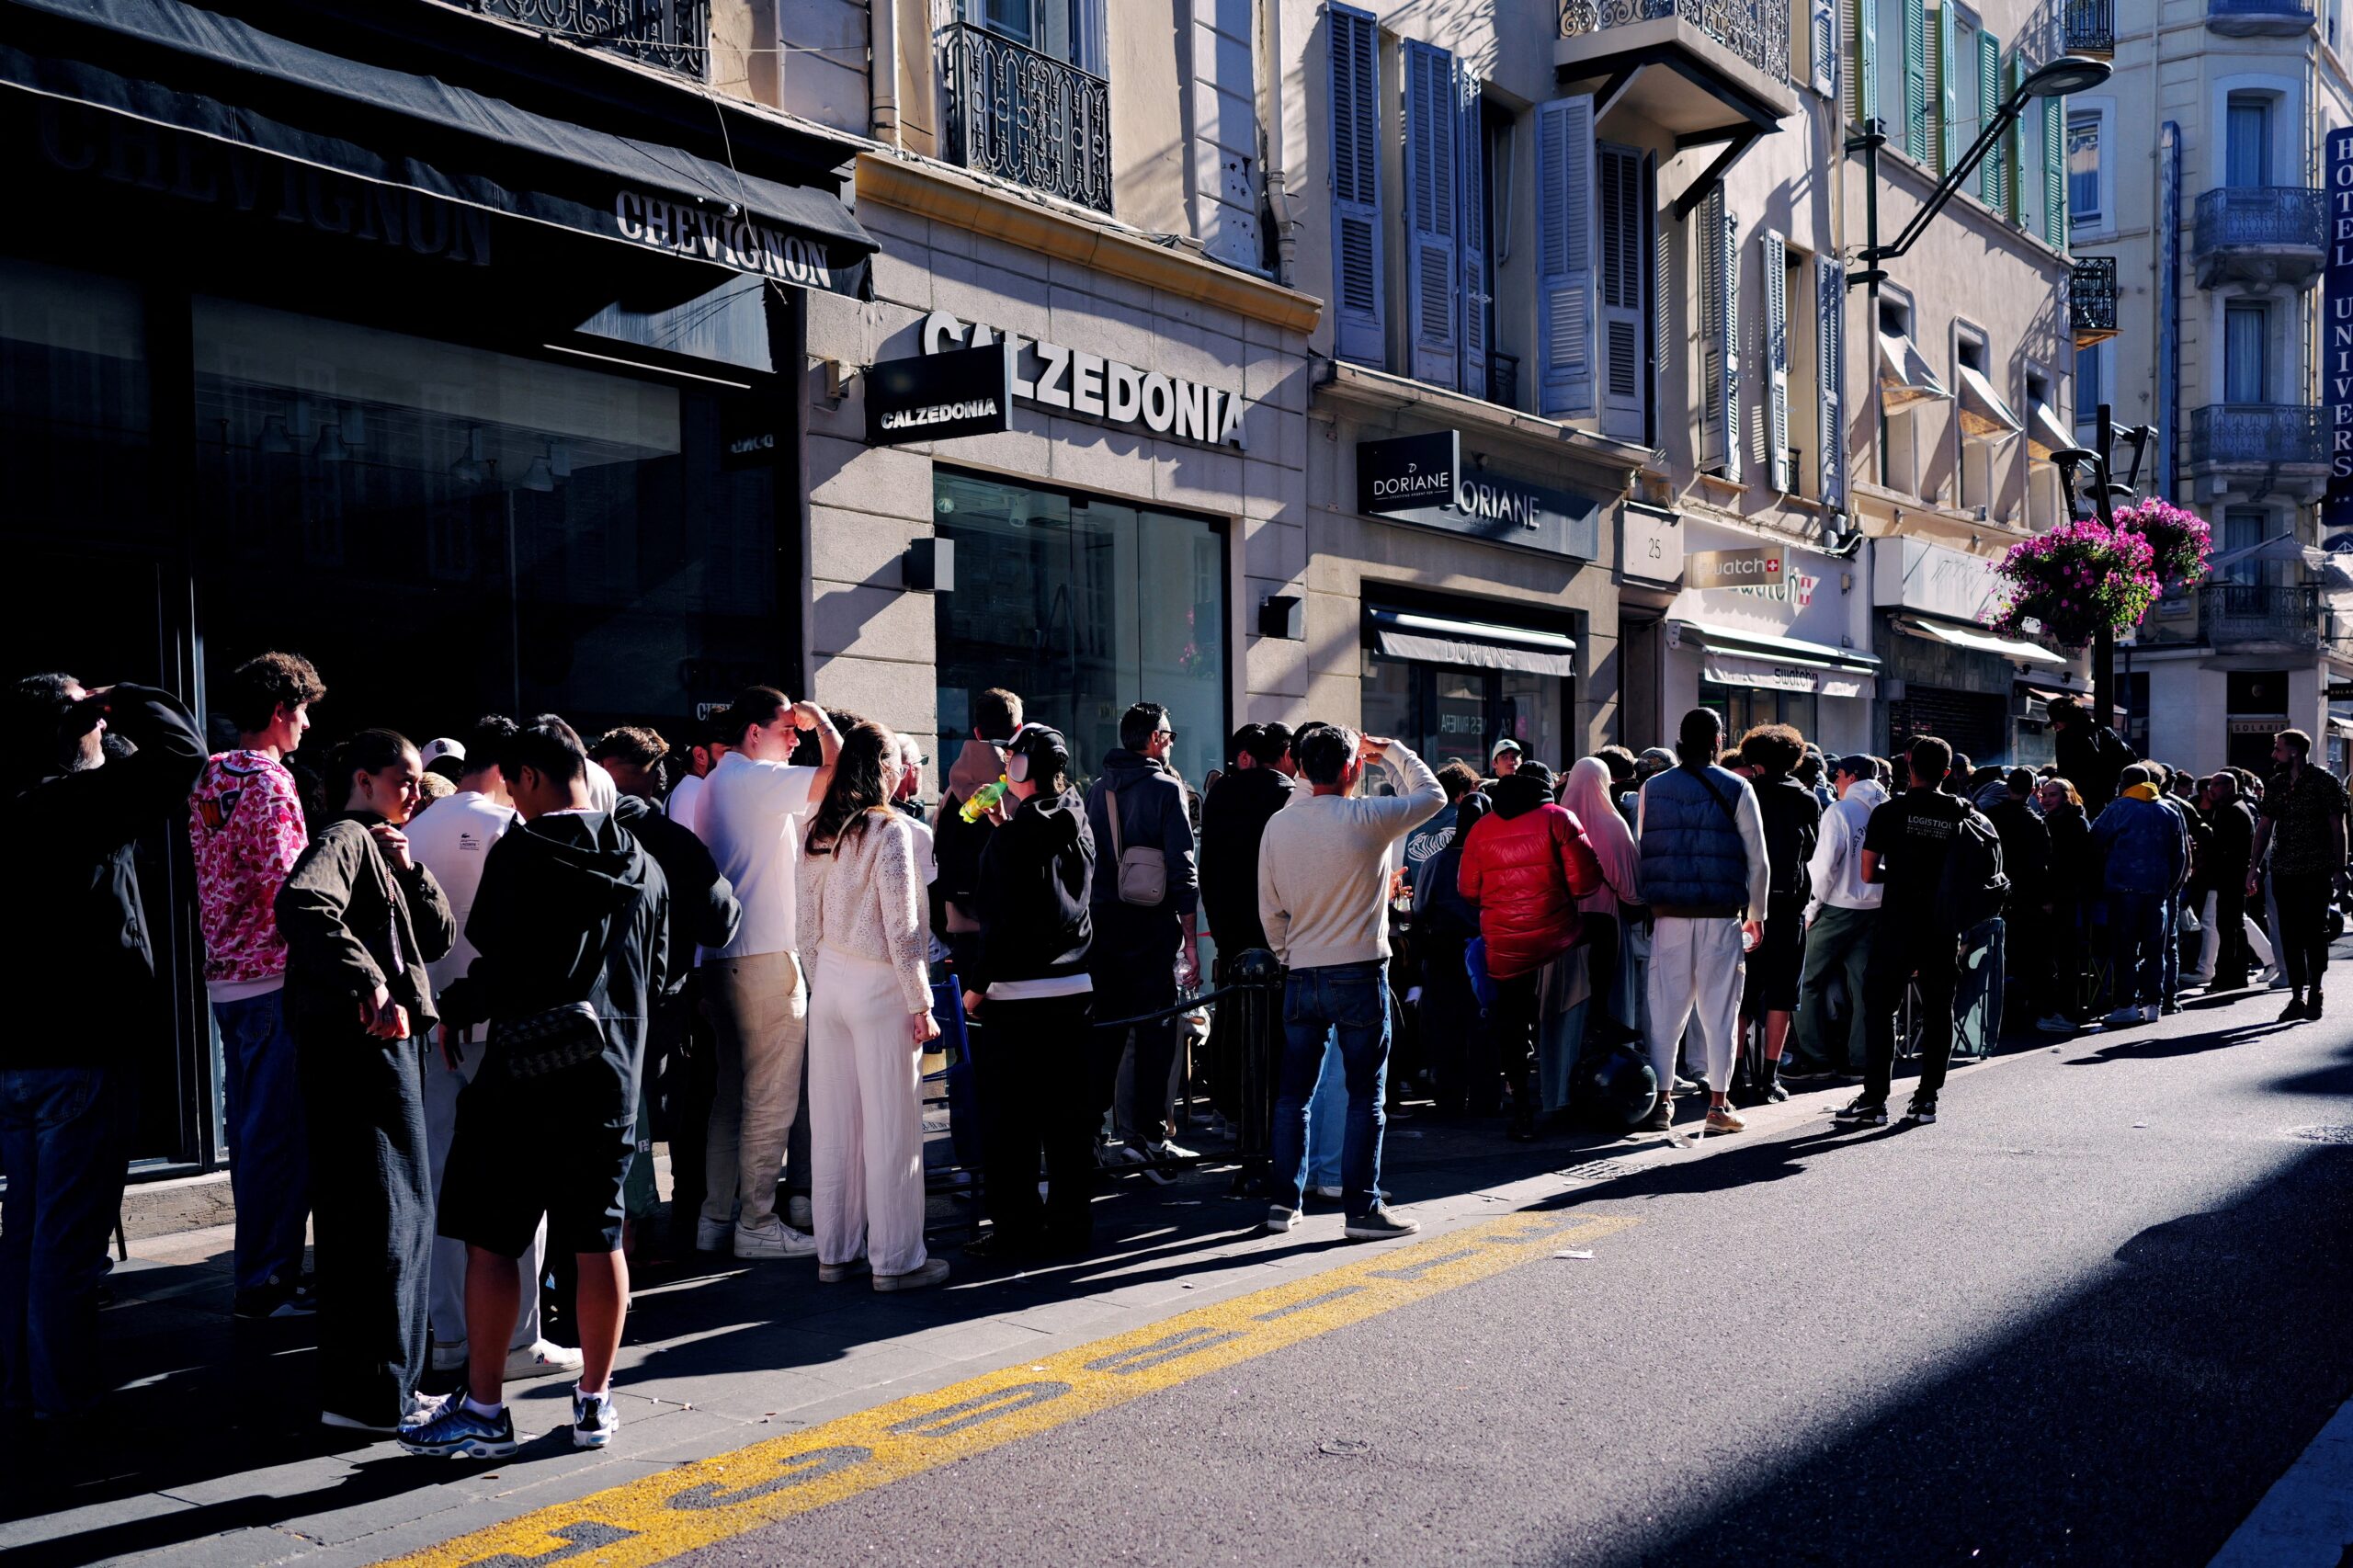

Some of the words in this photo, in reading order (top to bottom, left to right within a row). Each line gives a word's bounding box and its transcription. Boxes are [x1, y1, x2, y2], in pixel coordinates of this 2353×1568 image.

[2335, 138, 2353, 267] HOTEL
[615, 189, 832, 288] CHEVIGNON
[2332, 297, 2353, 478] UNIVERS
[881, 397, 998, 430] CALZEDONIA
[1373, 472, 1449, 495] DORIANE
[1460, 480, 1540, 528] ORIANE
[1648, 538, 1661, 560] 25
[1446, 639, 1515, 669] DORIANE
[1774, 666, 1813, 687] swatch
[2234, 723, 2286, 733] SOLARIS
